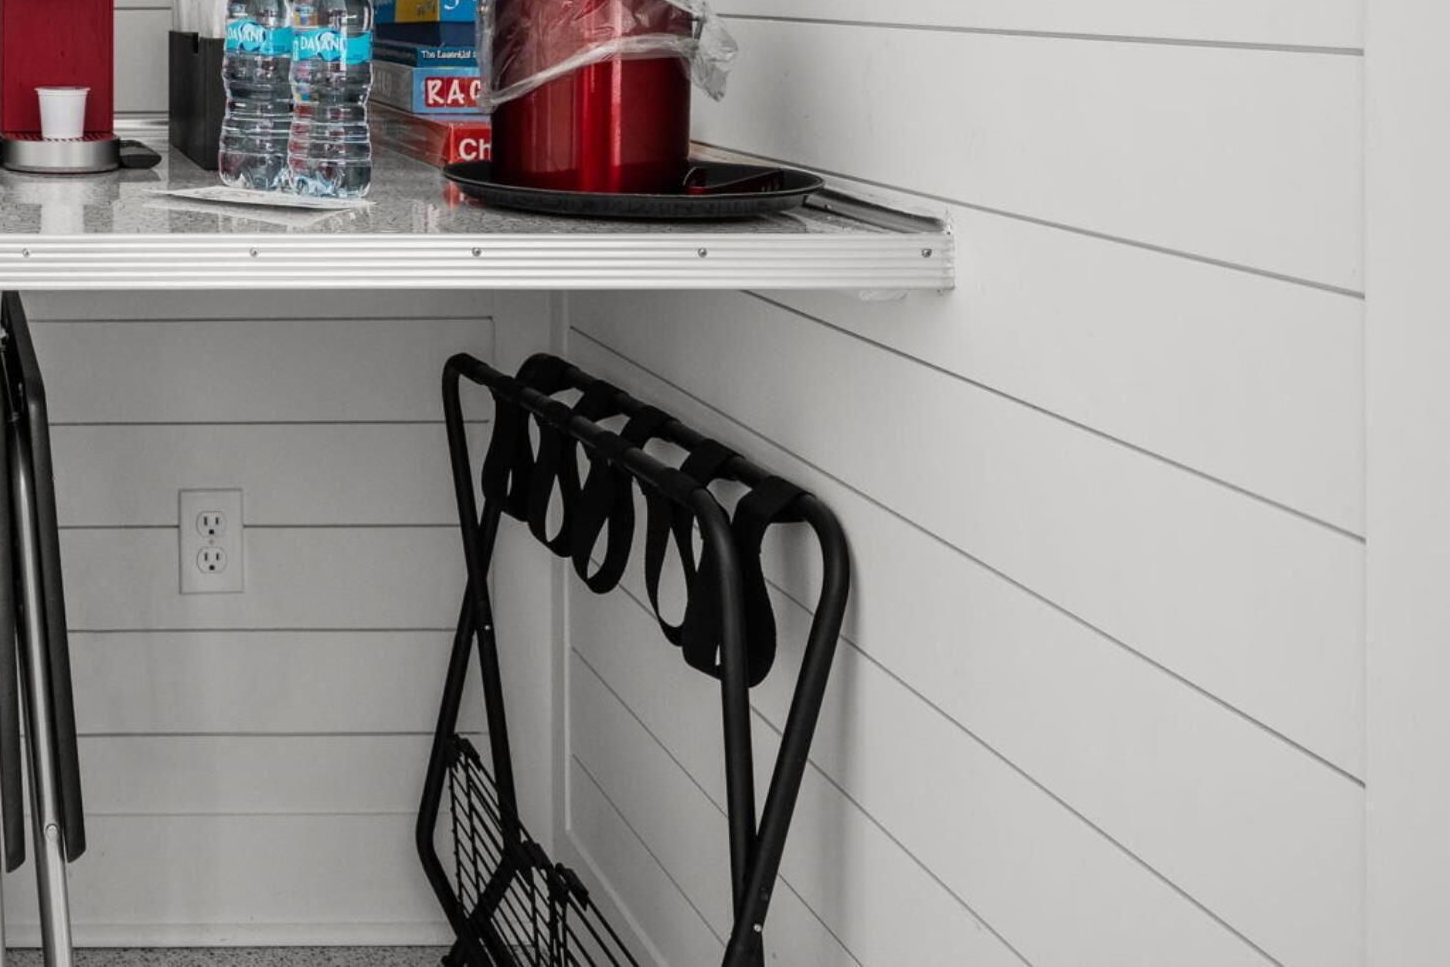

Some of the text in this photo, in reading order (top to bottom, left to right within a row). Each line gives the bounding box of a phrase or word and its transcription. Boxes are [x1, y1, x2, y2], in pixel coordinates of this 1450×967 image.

[227, 24, 263, 43] DASANI
[300, 35, 343, 54] DASANI
[422, 50, 435, 59] The
